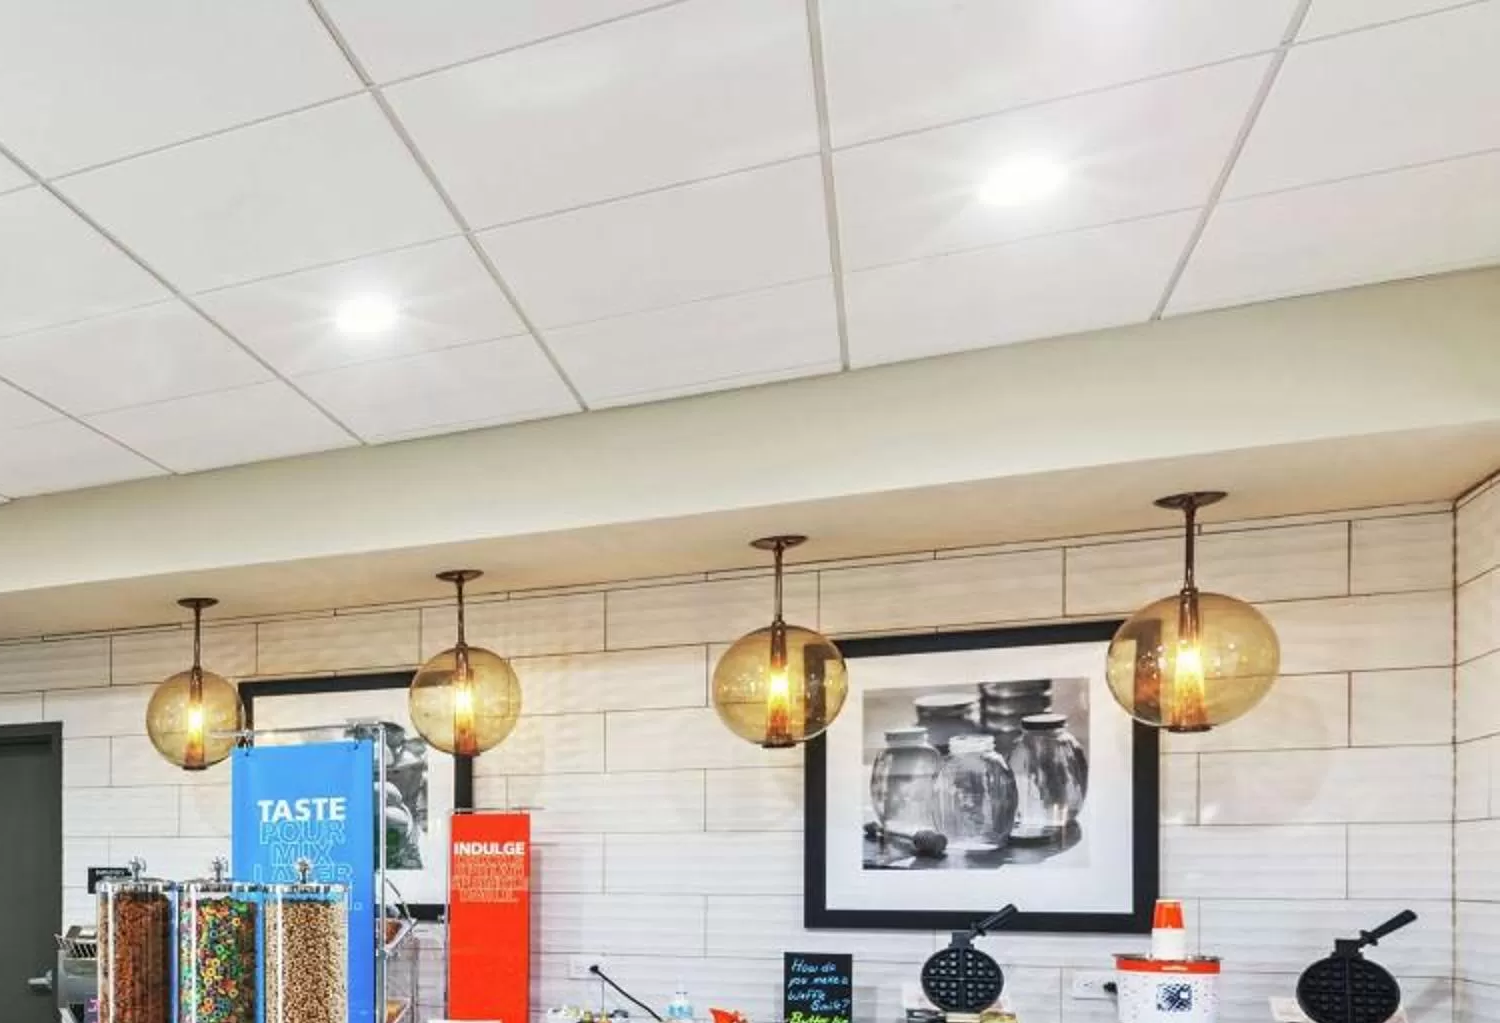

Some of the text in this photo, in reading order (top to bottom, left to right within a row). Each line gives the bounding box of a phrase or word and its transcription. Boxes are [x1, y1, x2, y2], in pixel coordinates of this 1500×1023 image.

[257, 796, 347, 822] TASTE
[259, 820, 346, 845] POUR
[271, 842, 334, 865] MIX
[453, 841, 526, 856] INDULGE
